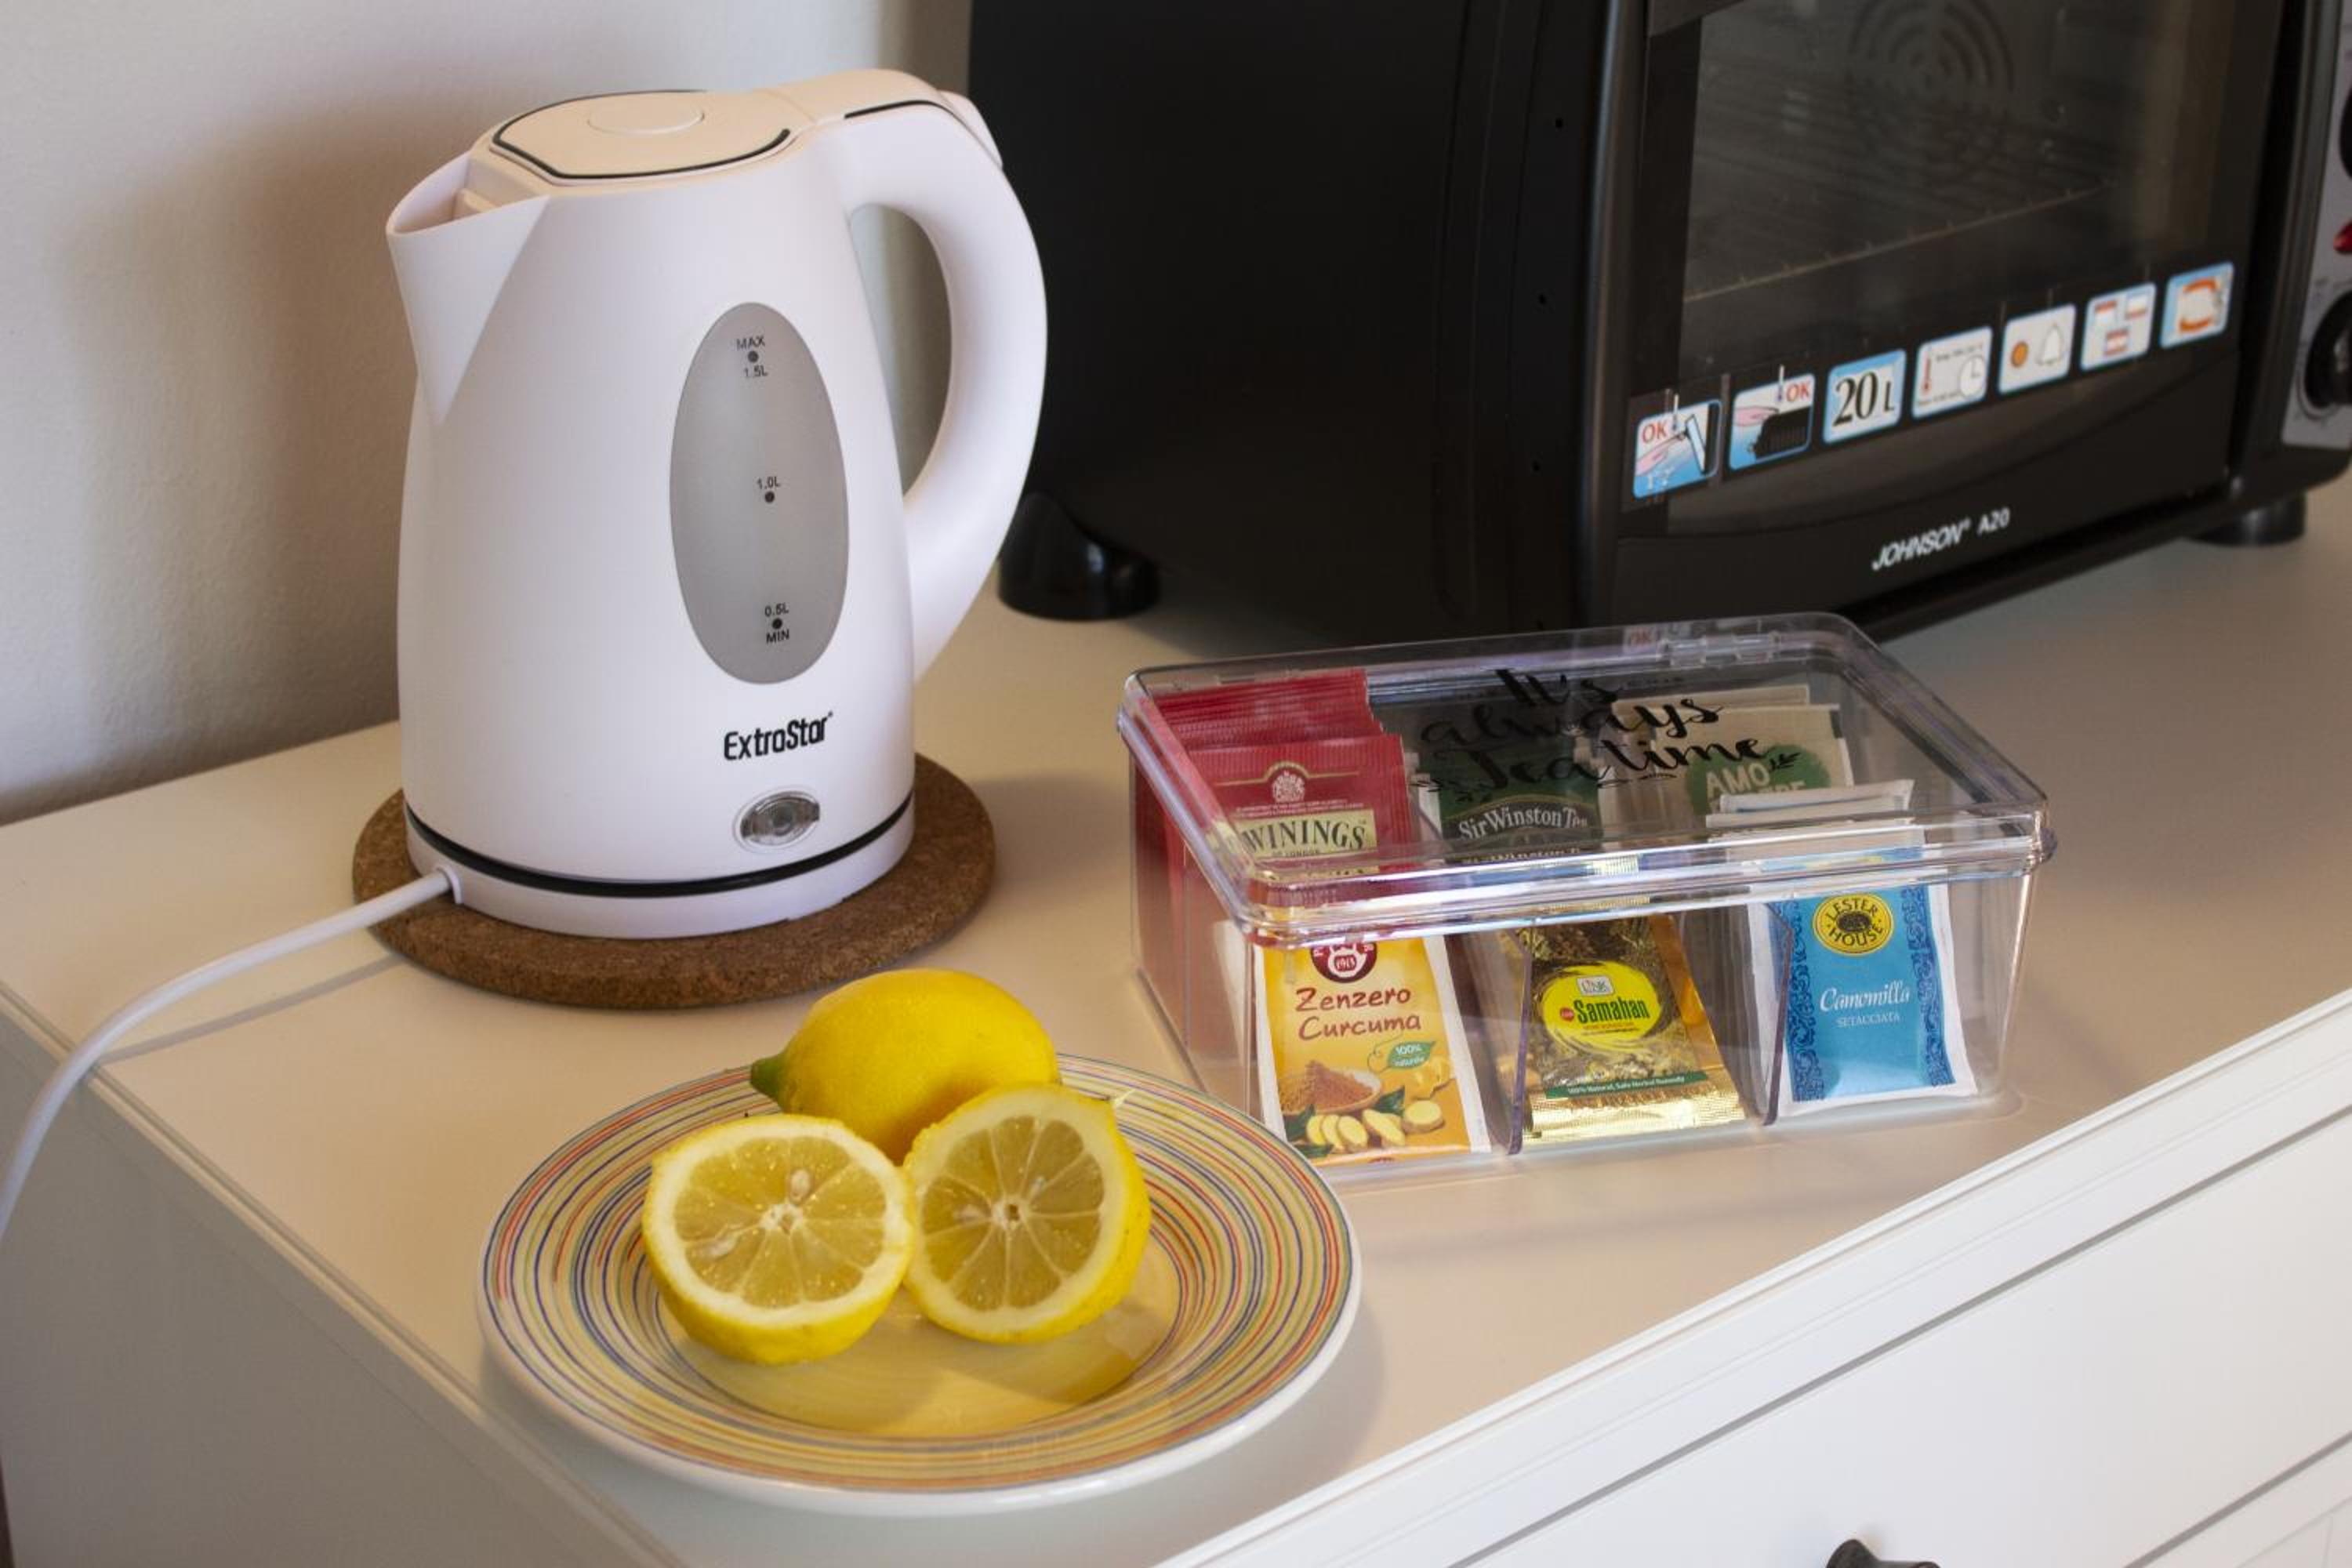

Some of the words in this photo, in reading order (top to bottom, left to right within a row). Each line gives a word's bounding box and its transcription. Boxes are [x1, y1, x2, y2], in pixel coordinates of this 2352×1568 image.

[736, 336, 765, 350] MAX
[743, 365, 768, 379] 1.5L
[1787, 383, 1810, 401] OK
[1642, 418, 1667, 444] OK
[757, 476, 780, 489] 1.0L
[1871, 520, 1966, 571] JOHNSON
[1977, 507, 2011, 536] A20
[764, 603, 789, 617] 0.5L
[766, 630, 790, 644] MIN
[1705, 761, 1771, 800] AMO
[1239, 819, 1367, 852] WININGS
[1825, 898, 1878, 921] LESTER
[1828, 924, 1883, 946] HOUSE
[1294, 986, 1412, 1013] Zenzero
[1819, 979, 1911, 1012] Camomilla
[1573, 995, 1650, 1024] Samahan
[1298, 1014, 1421, 1041] Curcuma
